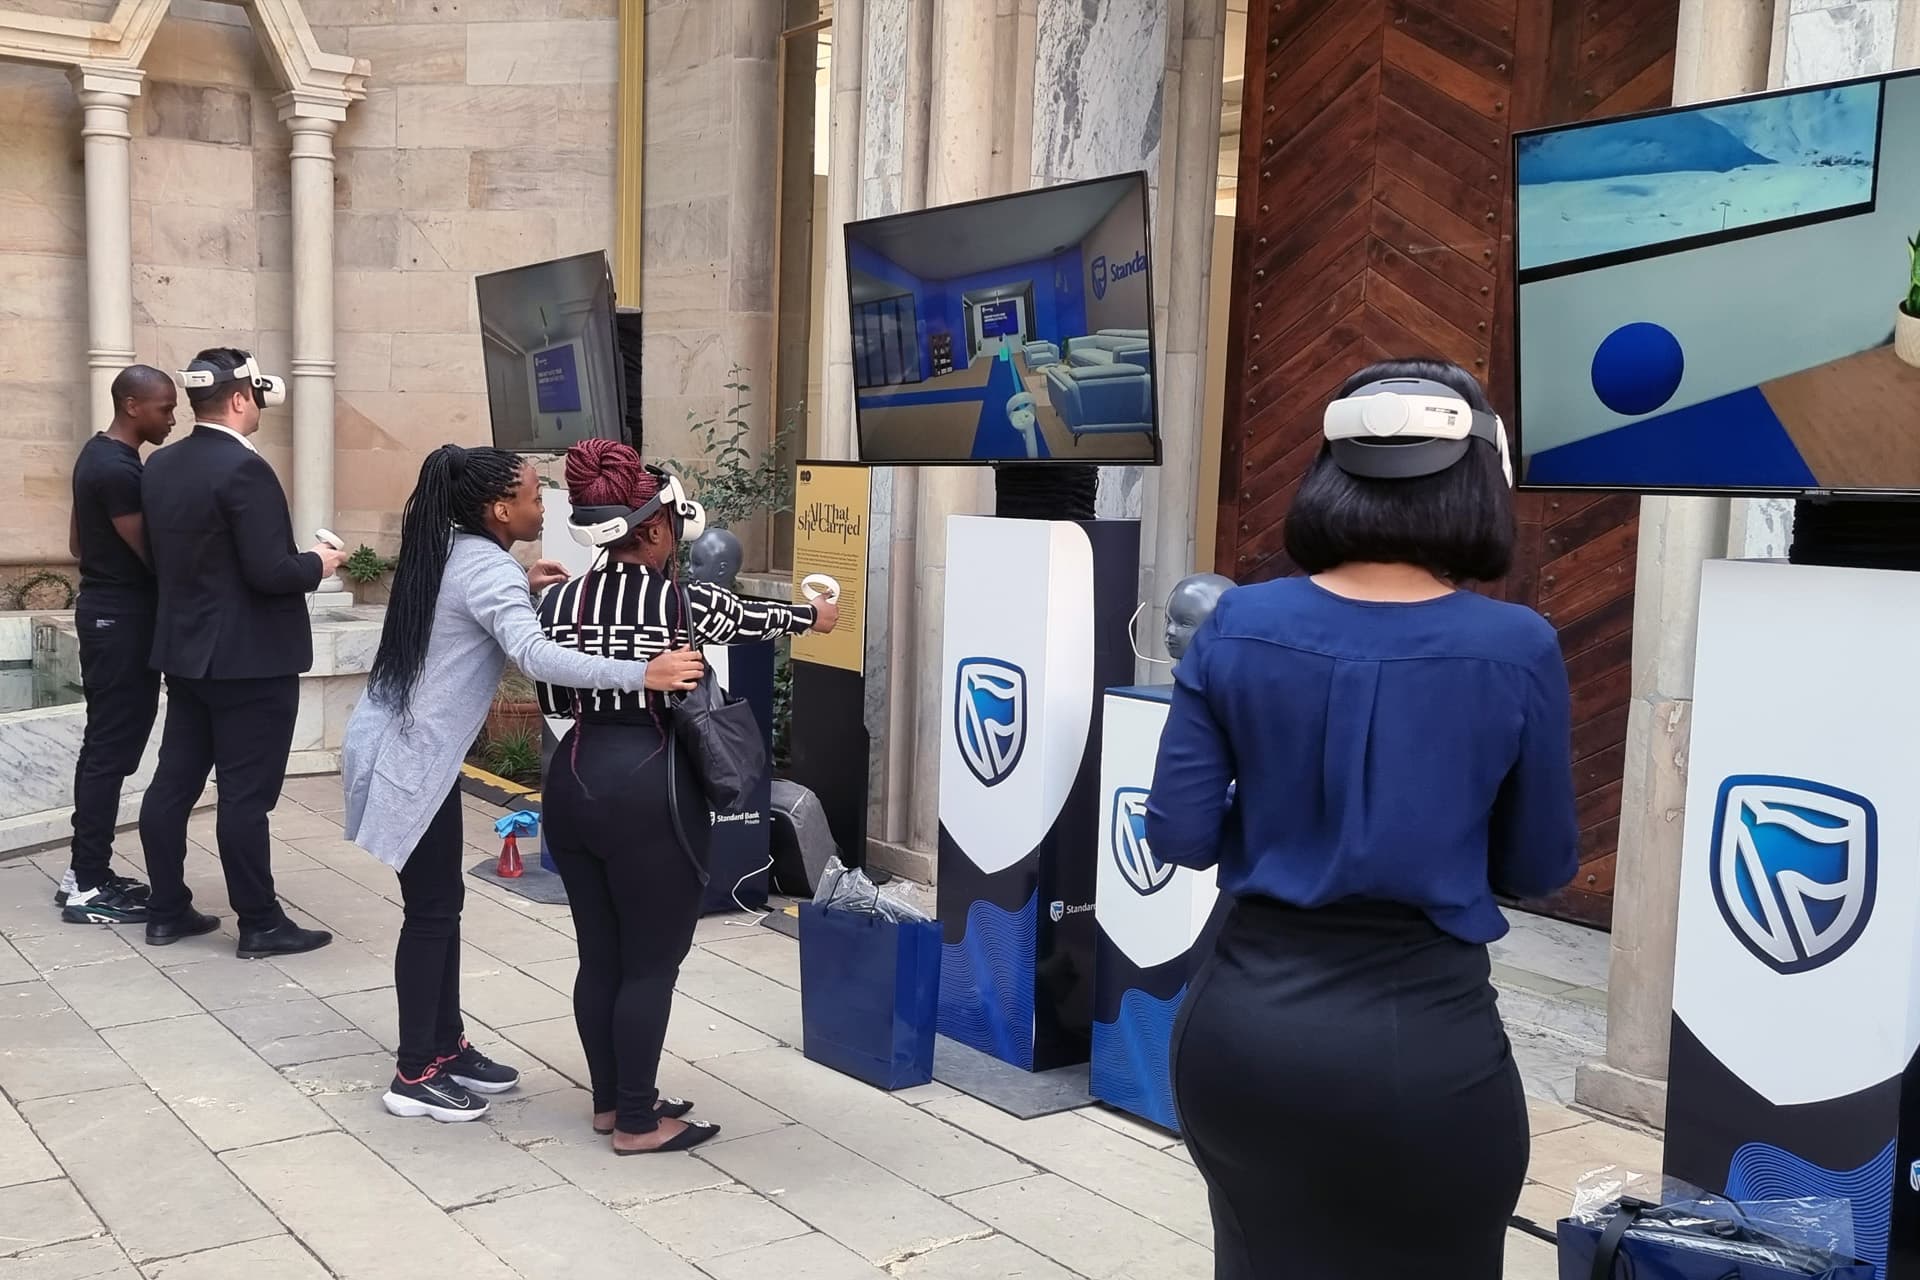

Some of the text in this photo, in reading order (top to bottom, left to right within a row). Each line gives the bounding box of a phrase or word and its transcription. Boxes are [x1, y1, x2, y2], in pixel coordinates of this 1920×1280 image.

[807, 502, 849, 523] All That
[798, 510, 860, 544] She Carried
[717, 811, 760, 823] Standard Bank
